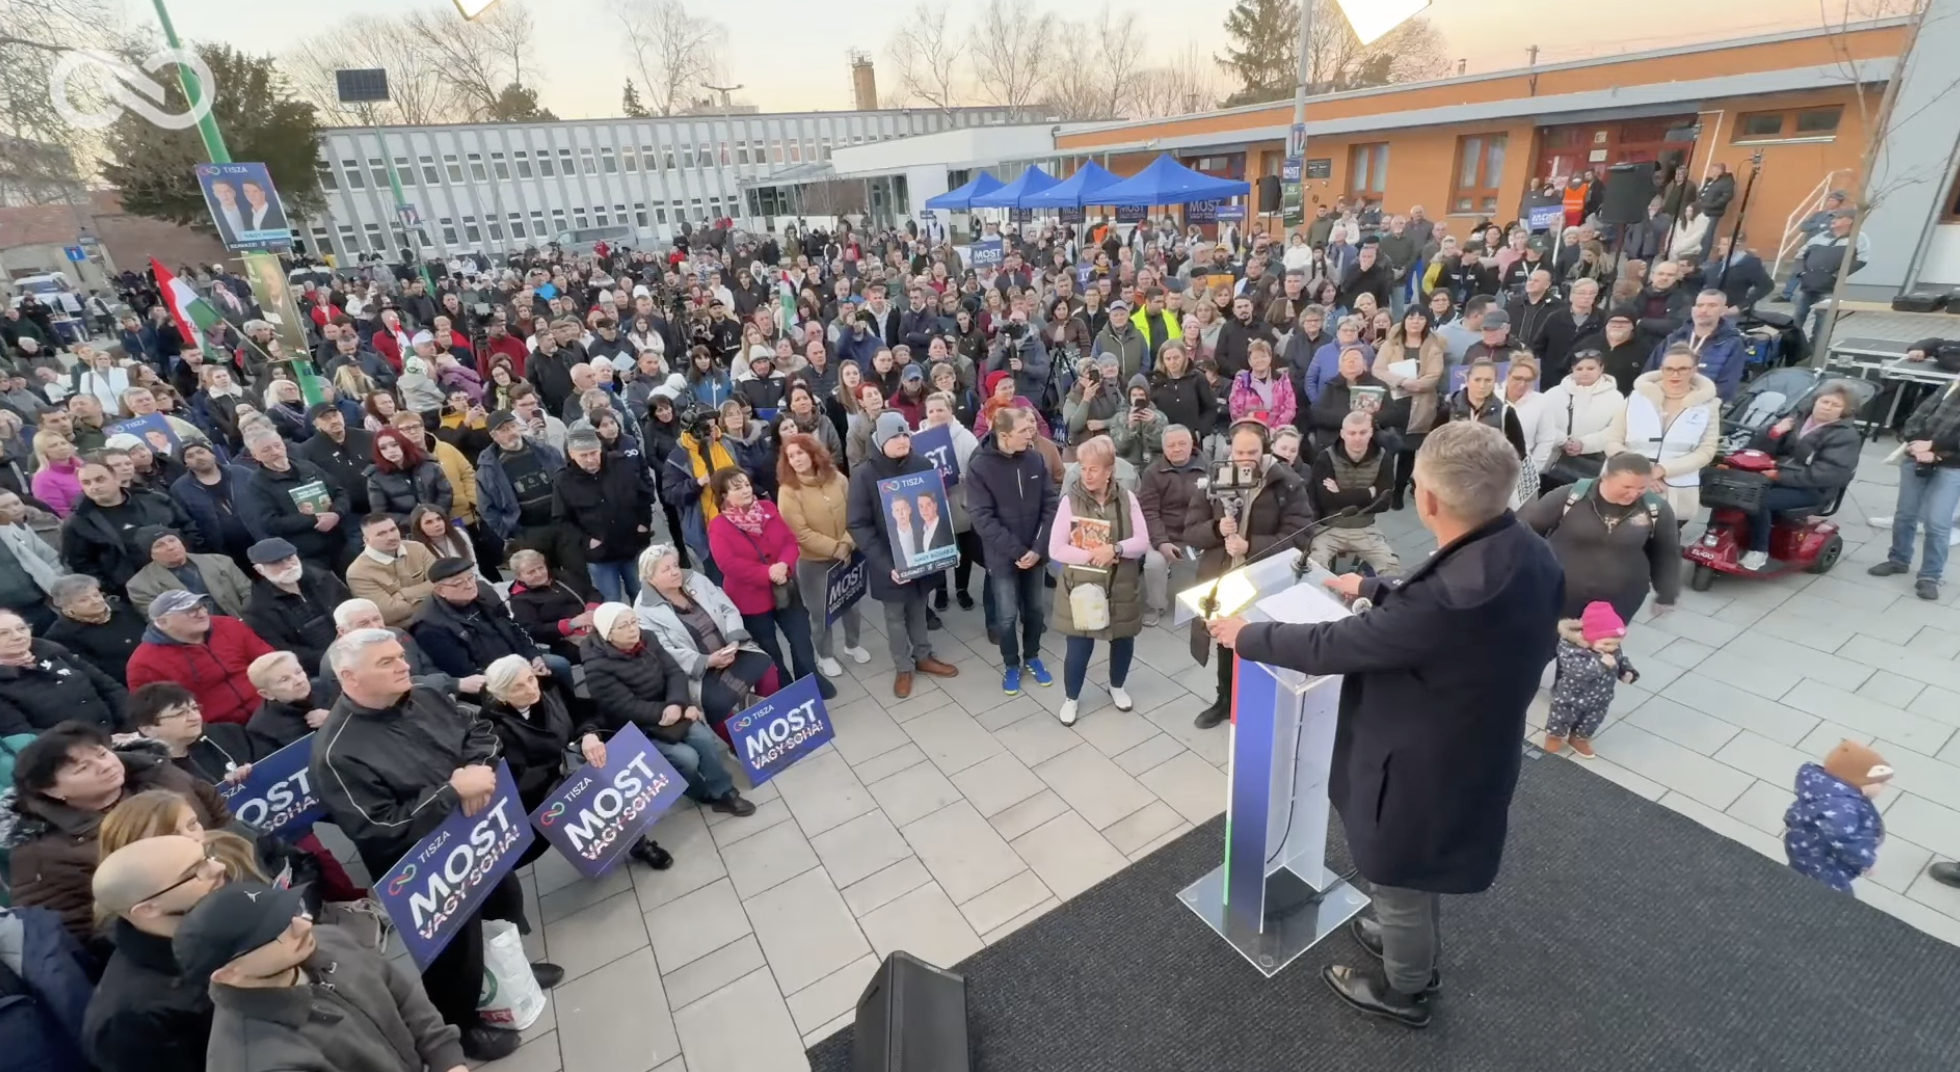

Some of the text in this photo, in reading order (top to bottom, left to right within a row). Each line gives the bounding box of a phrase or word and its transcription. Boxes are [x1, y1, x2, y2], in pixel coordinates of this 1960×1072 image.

[1189, 199, 1221, 212] MOST
[974, 248, 1001, 260] MOST
[125, 419, 148, 429] TISZA
[925, 445, 947, 470] ST
[902, 476, 925, 488] TISZA
[829, 561, 866, 605] MOST
[752, 704, 775, 720] TISZA
[745, 698, 817, 760] MOST
[751, 719, 823, 770] VAGY SOHA!
[220, 783, 247, 800] SZA
[235, 766, 311, 827] OST
[563, 776, 593, 802] TISZA
[563, 750, 655, 852] MOST
[581, 773, 669, 861] VAGY SOHA!
[408, 796, 509, 929] MOST
[417, 830, 451, 863] TISZA
[419, 824, 520, 940] VAGY SOHA!
